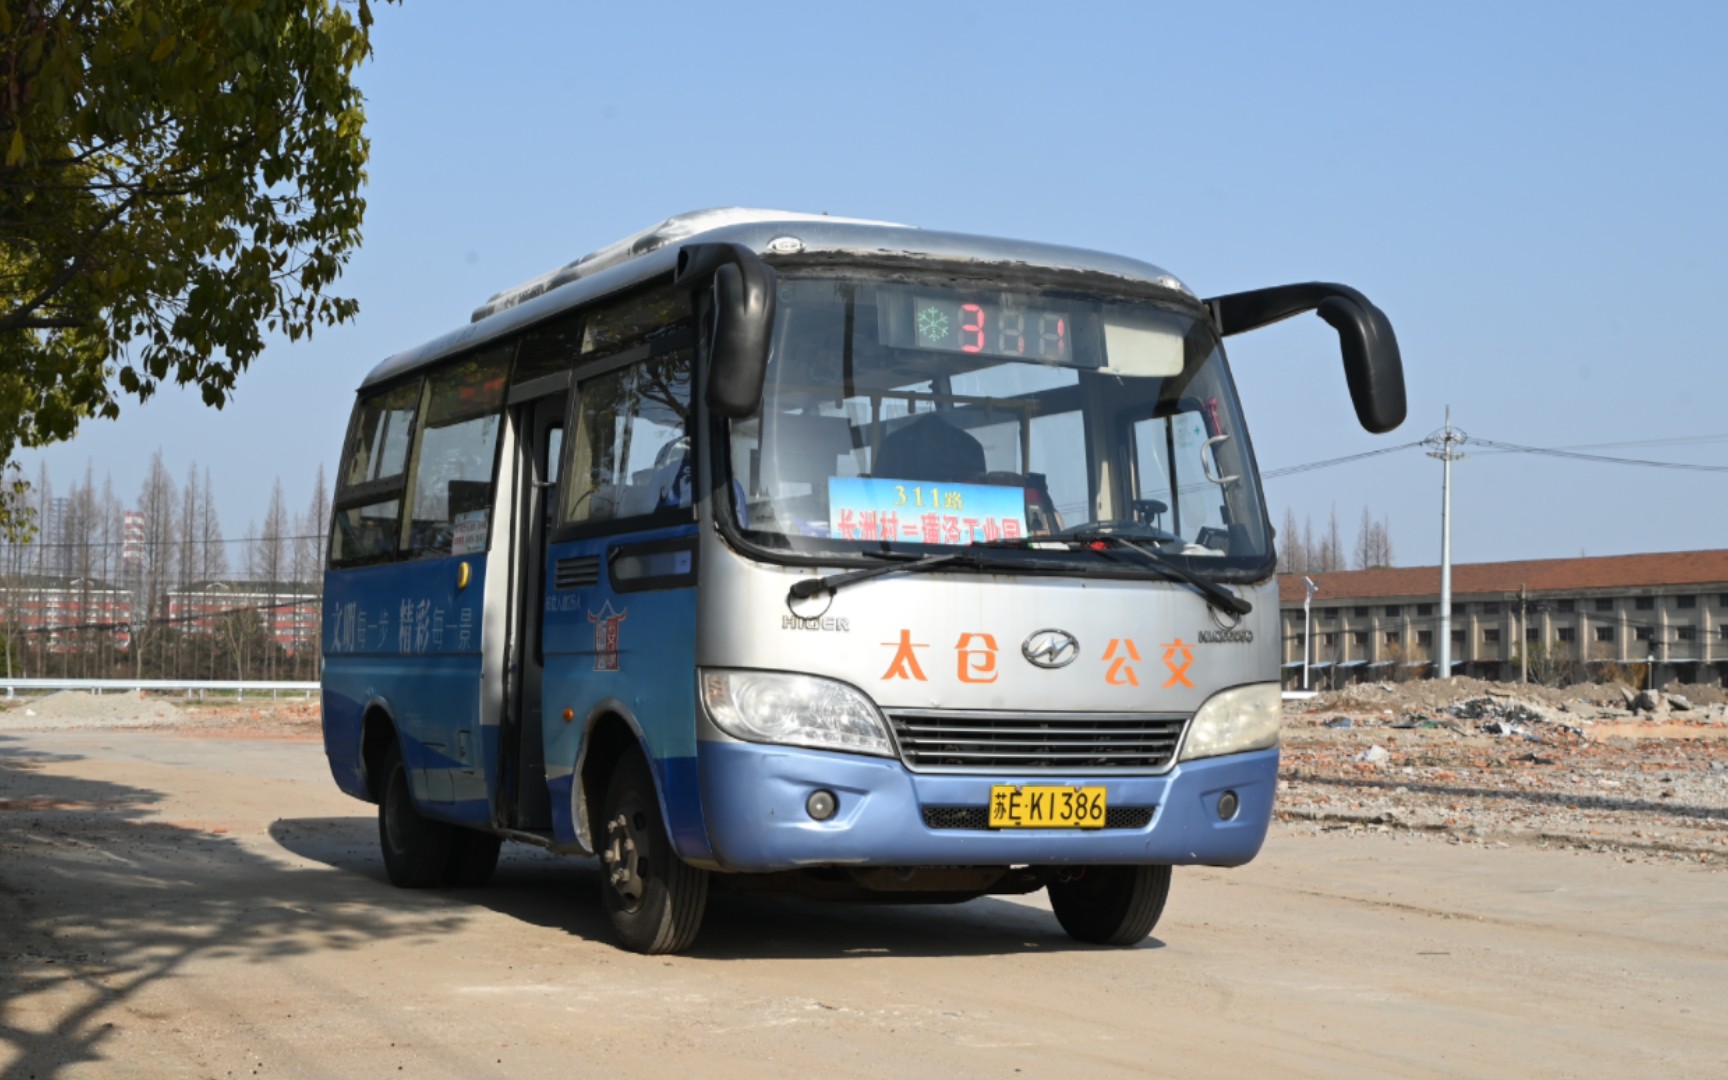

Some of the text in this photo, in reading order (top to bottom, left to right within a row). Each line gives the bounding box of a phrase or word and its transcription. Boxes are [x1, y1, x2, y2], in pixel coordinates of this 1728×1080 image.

[331, 598, 473, 653] 文明每一步 精彩每一景
[880, 629, 1197, 688] 太仓 公交
